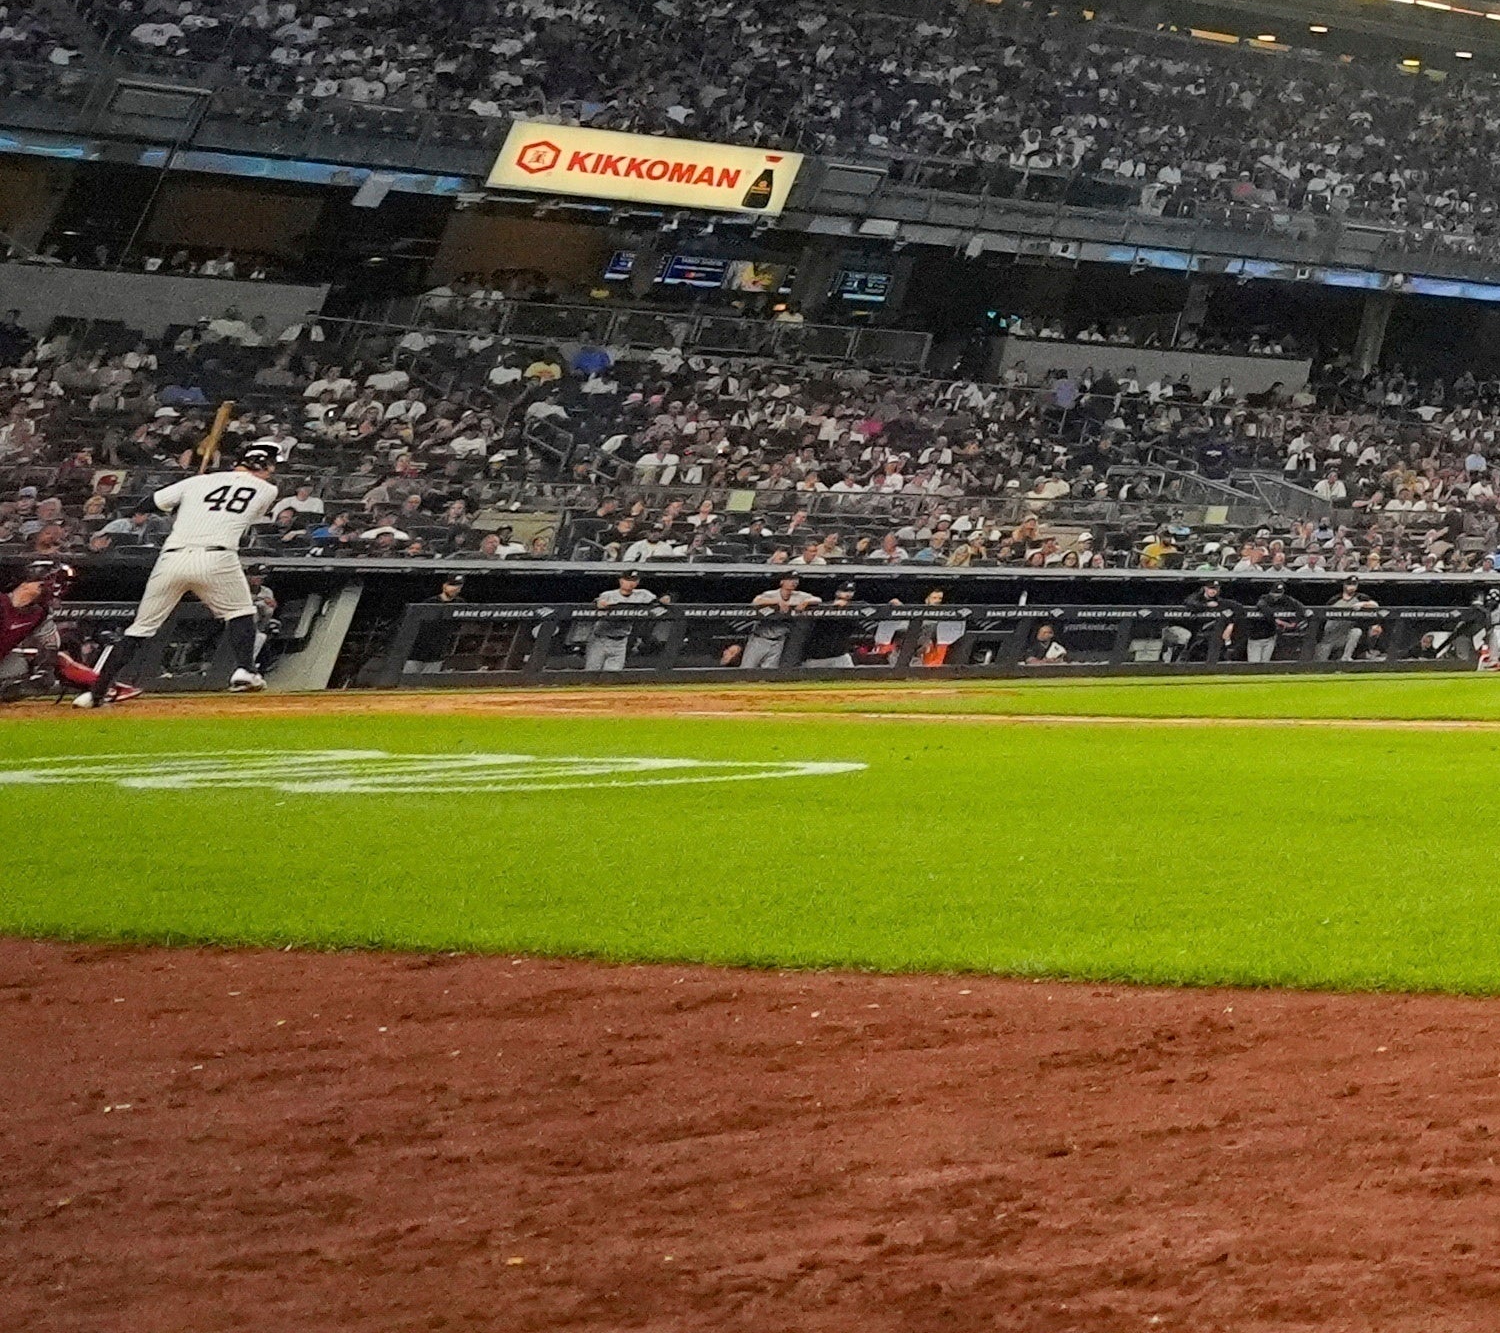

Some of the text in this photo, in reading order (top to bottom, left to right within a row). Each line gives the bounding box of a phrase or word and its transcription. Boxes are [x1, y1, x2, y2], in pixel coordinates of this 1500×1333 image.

[566, 150, 742, 189] KIKKOMAN
[203, 485, 256, 515] 48
[452, 609, 479, 617] BANK
[492, 609, 534, 617] AMERICA
